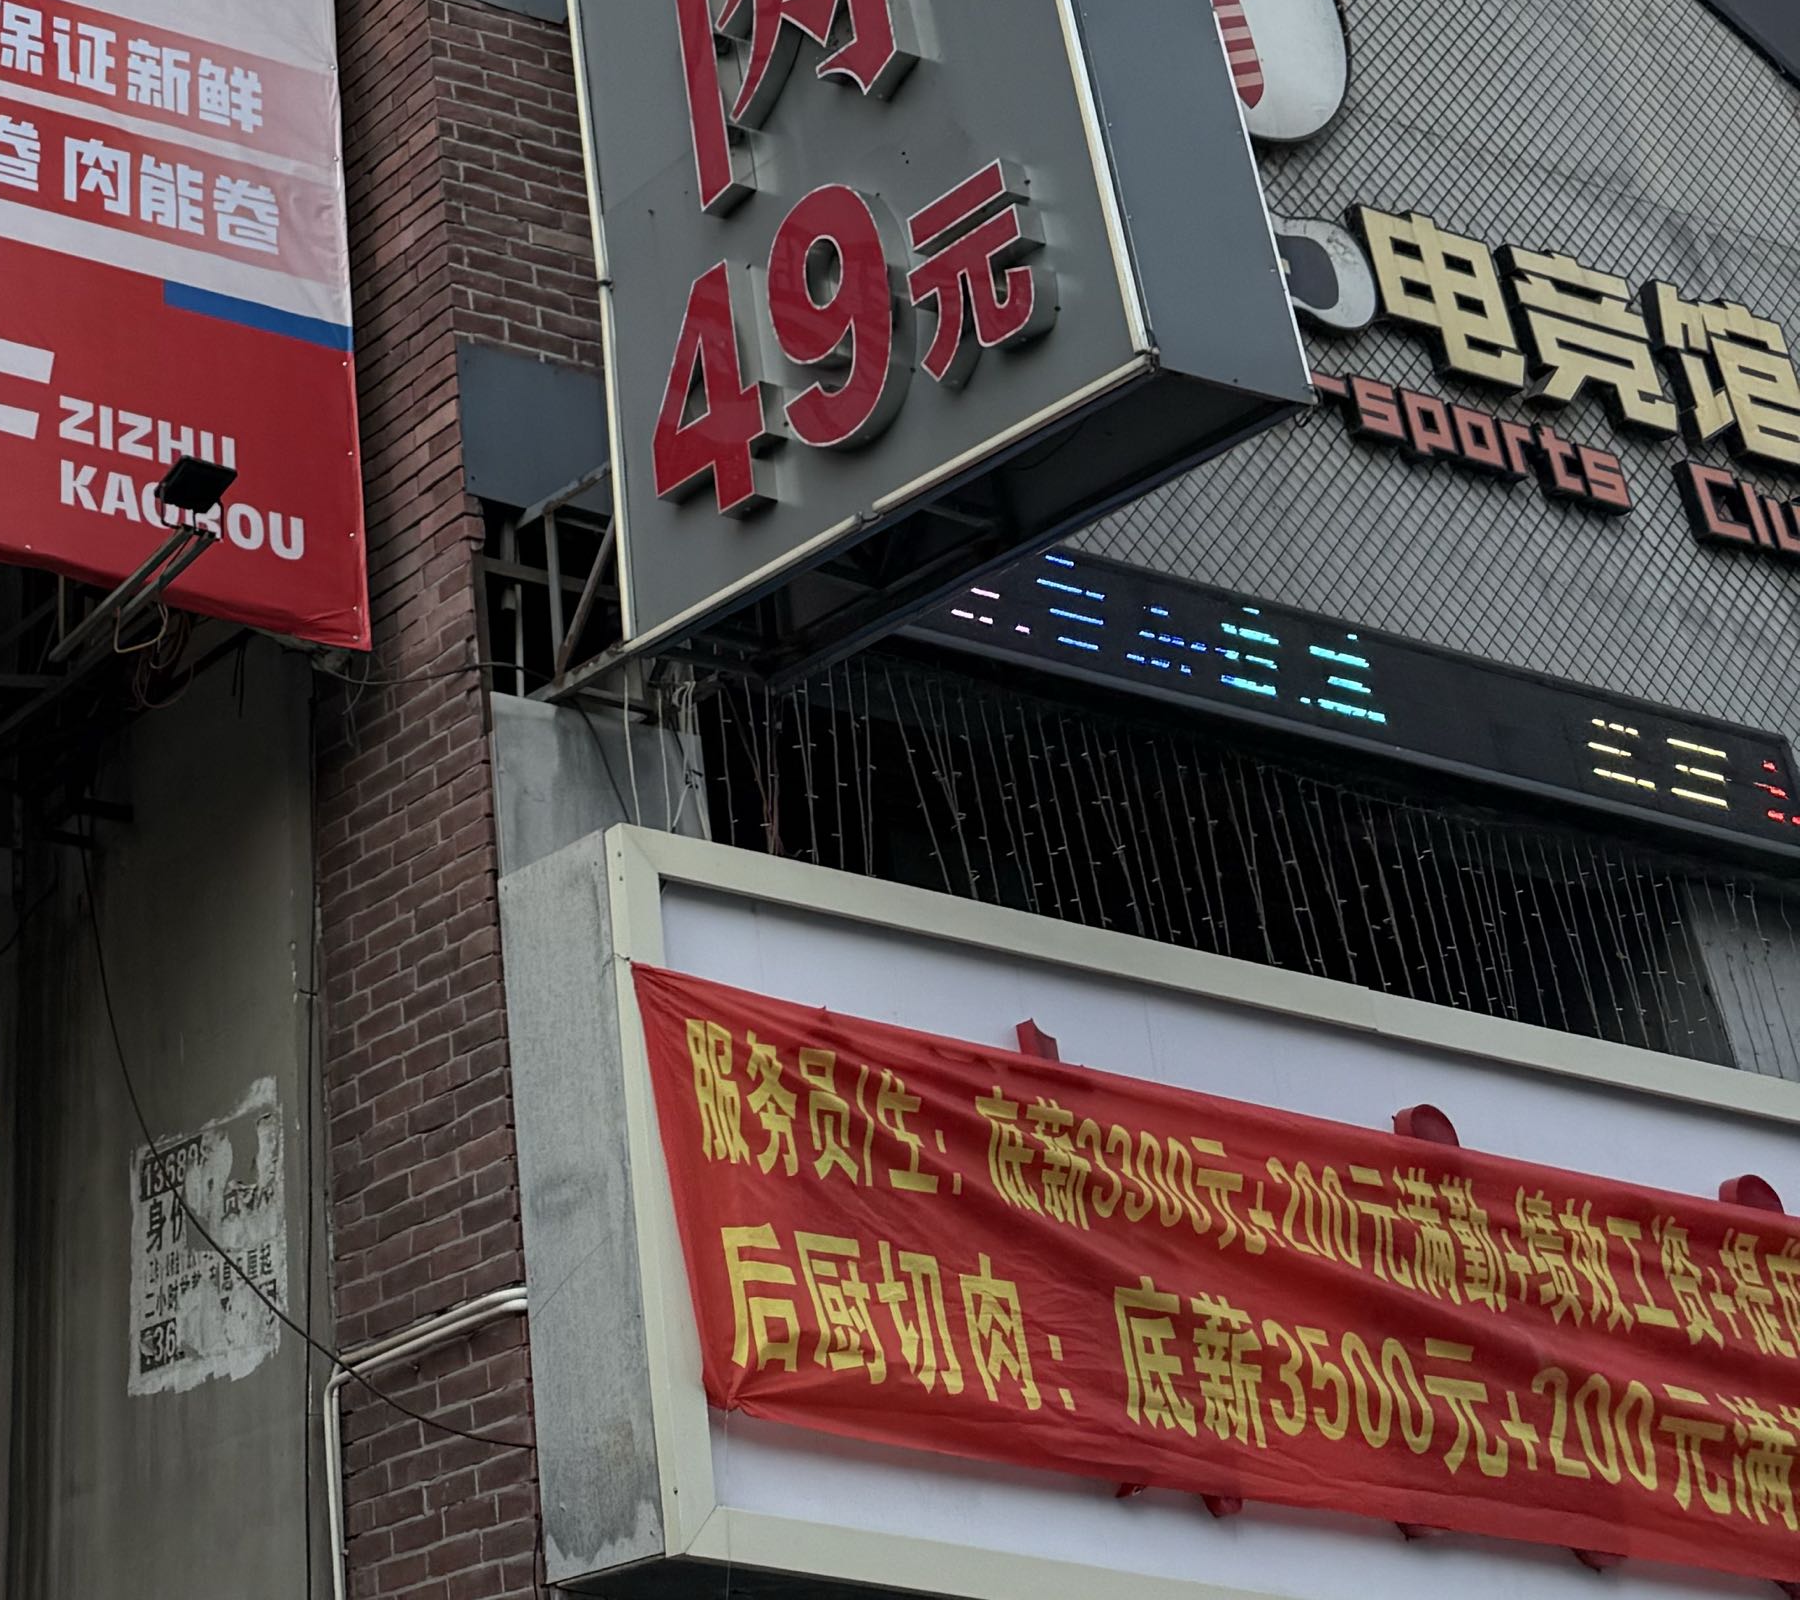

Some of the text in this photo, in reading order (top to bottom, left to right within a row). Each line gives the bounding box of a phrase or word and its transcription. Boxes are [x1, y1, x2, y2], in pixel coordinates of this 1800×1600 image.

[64, 137, 280, 255] 肉能卷
[653, 157, 1036, 516] 49元
[1352, 203, 1800, 468] 电竞馆
[58, 394, 236, 470] ZIZHU
